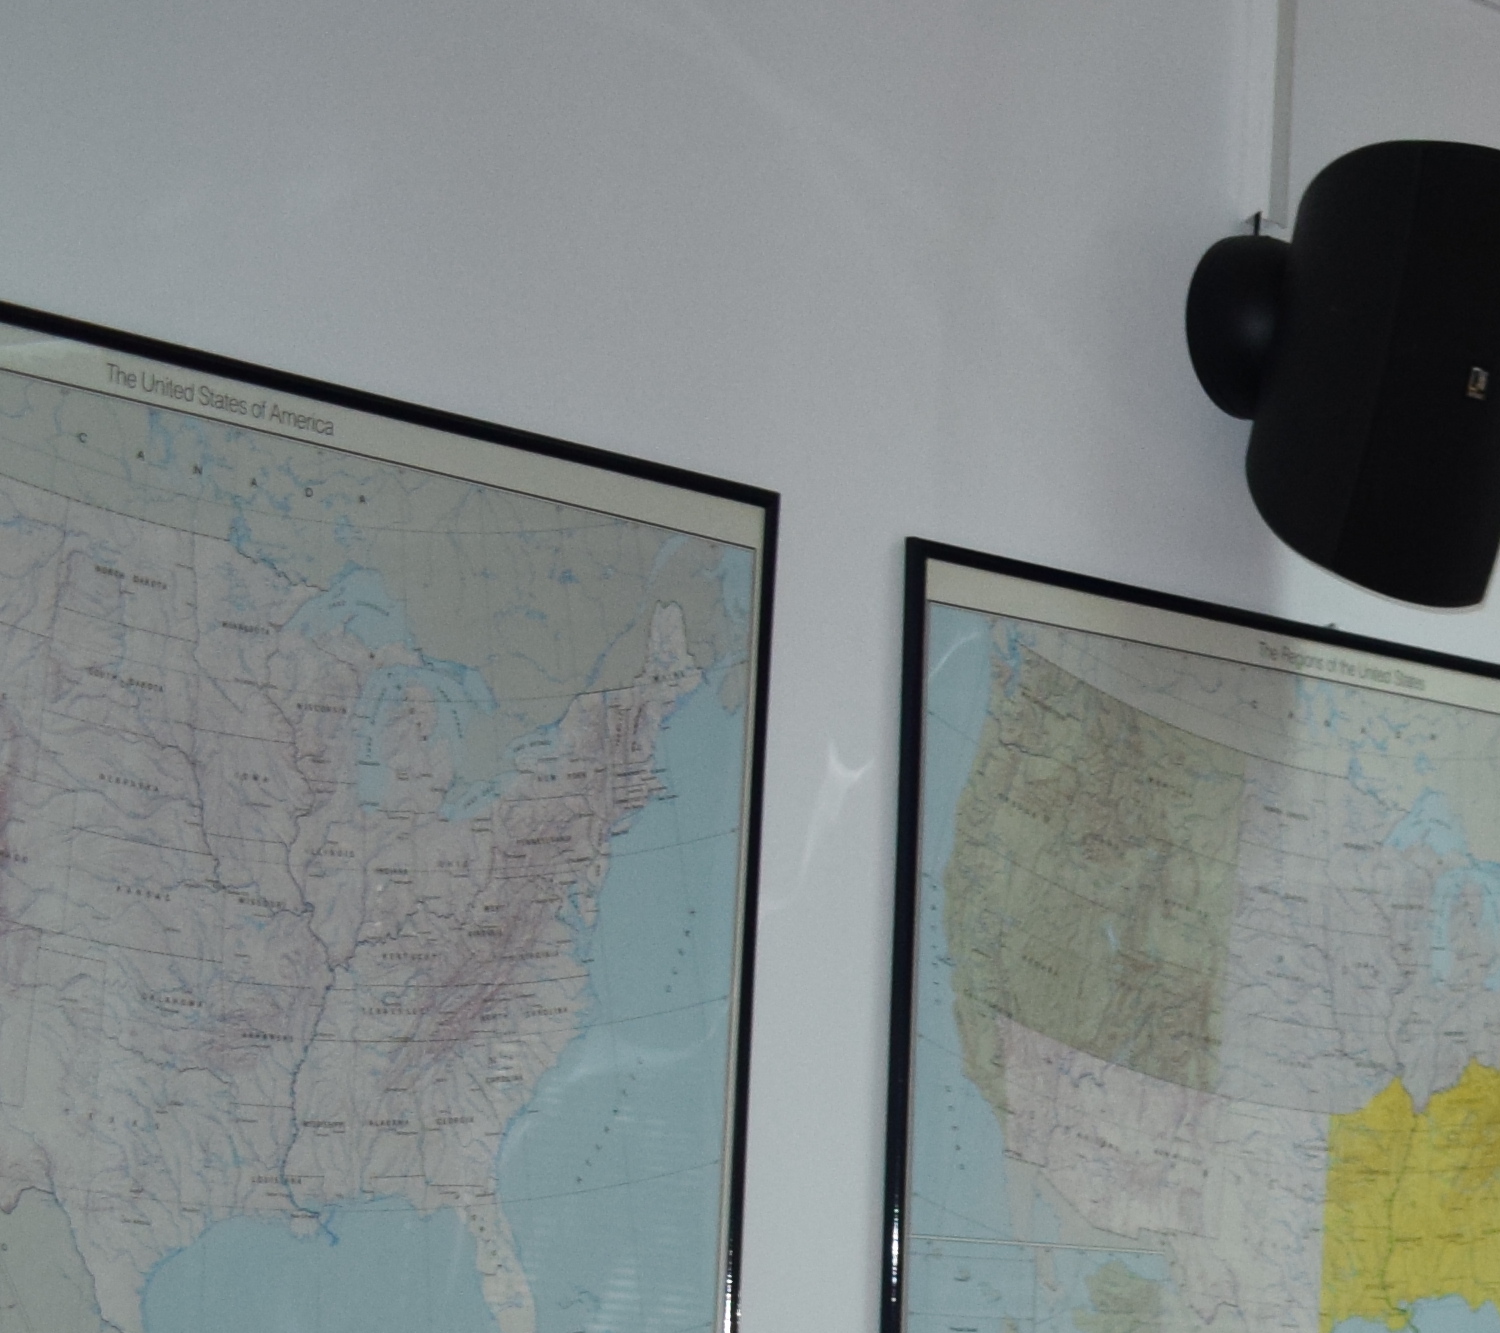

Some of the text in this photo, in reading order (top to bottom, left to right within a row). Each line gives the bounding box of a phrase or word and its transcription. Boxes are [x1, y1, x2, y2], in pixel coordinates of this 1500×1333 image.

[106, 362, 336, 438] The United States of America
[1259, 641, 1277, 661] The
[1281, 645, 1324, 669] Regions
